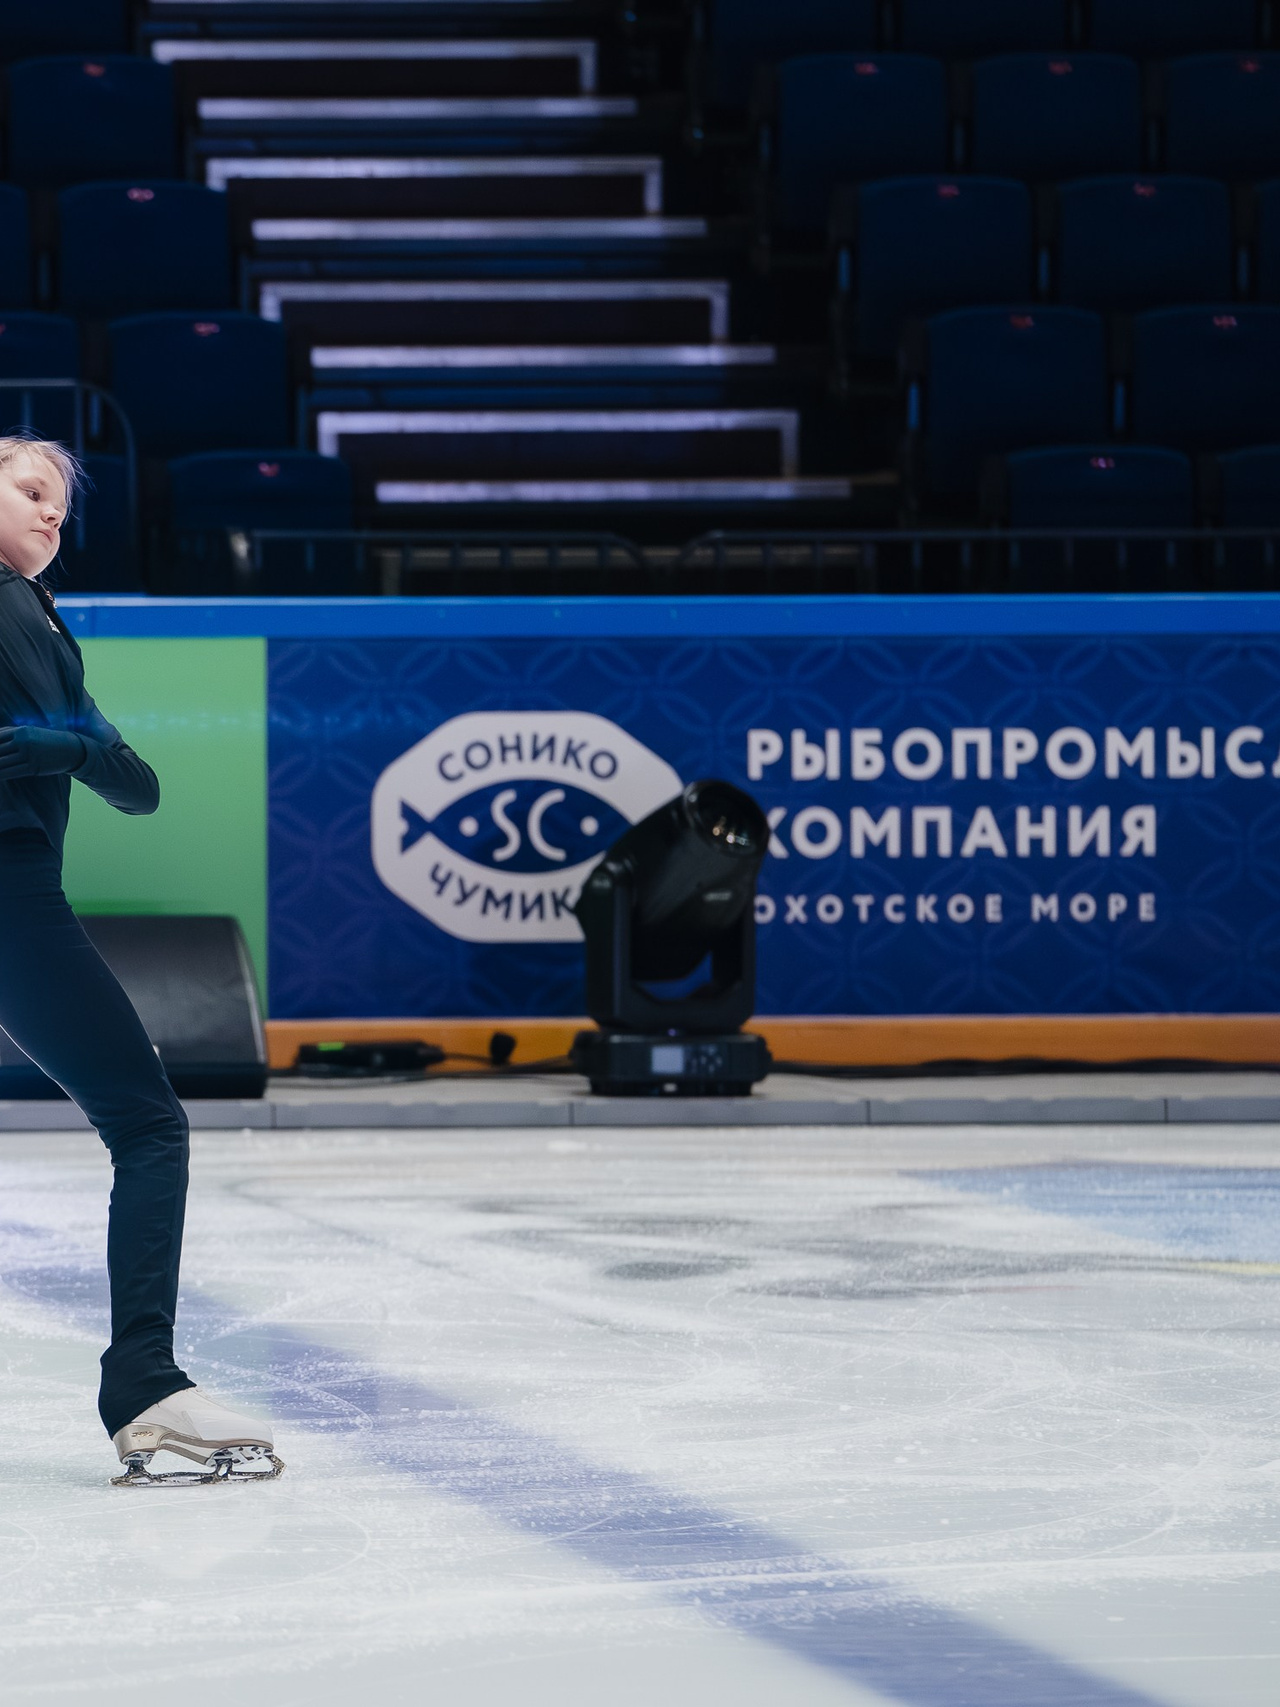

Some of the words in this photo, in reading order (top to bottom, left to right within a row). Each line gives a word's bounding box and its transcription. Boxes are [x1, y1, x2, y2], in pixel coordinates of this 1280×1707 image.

[438, 733, 618, 781] СОНИКО
[747, 726, 1280, 781] РЫБОПРОМЫС
[754, 894, 1003, 924] ОХОТСКОЕ
[1031, 892, 1156, 923] МОРЕ
